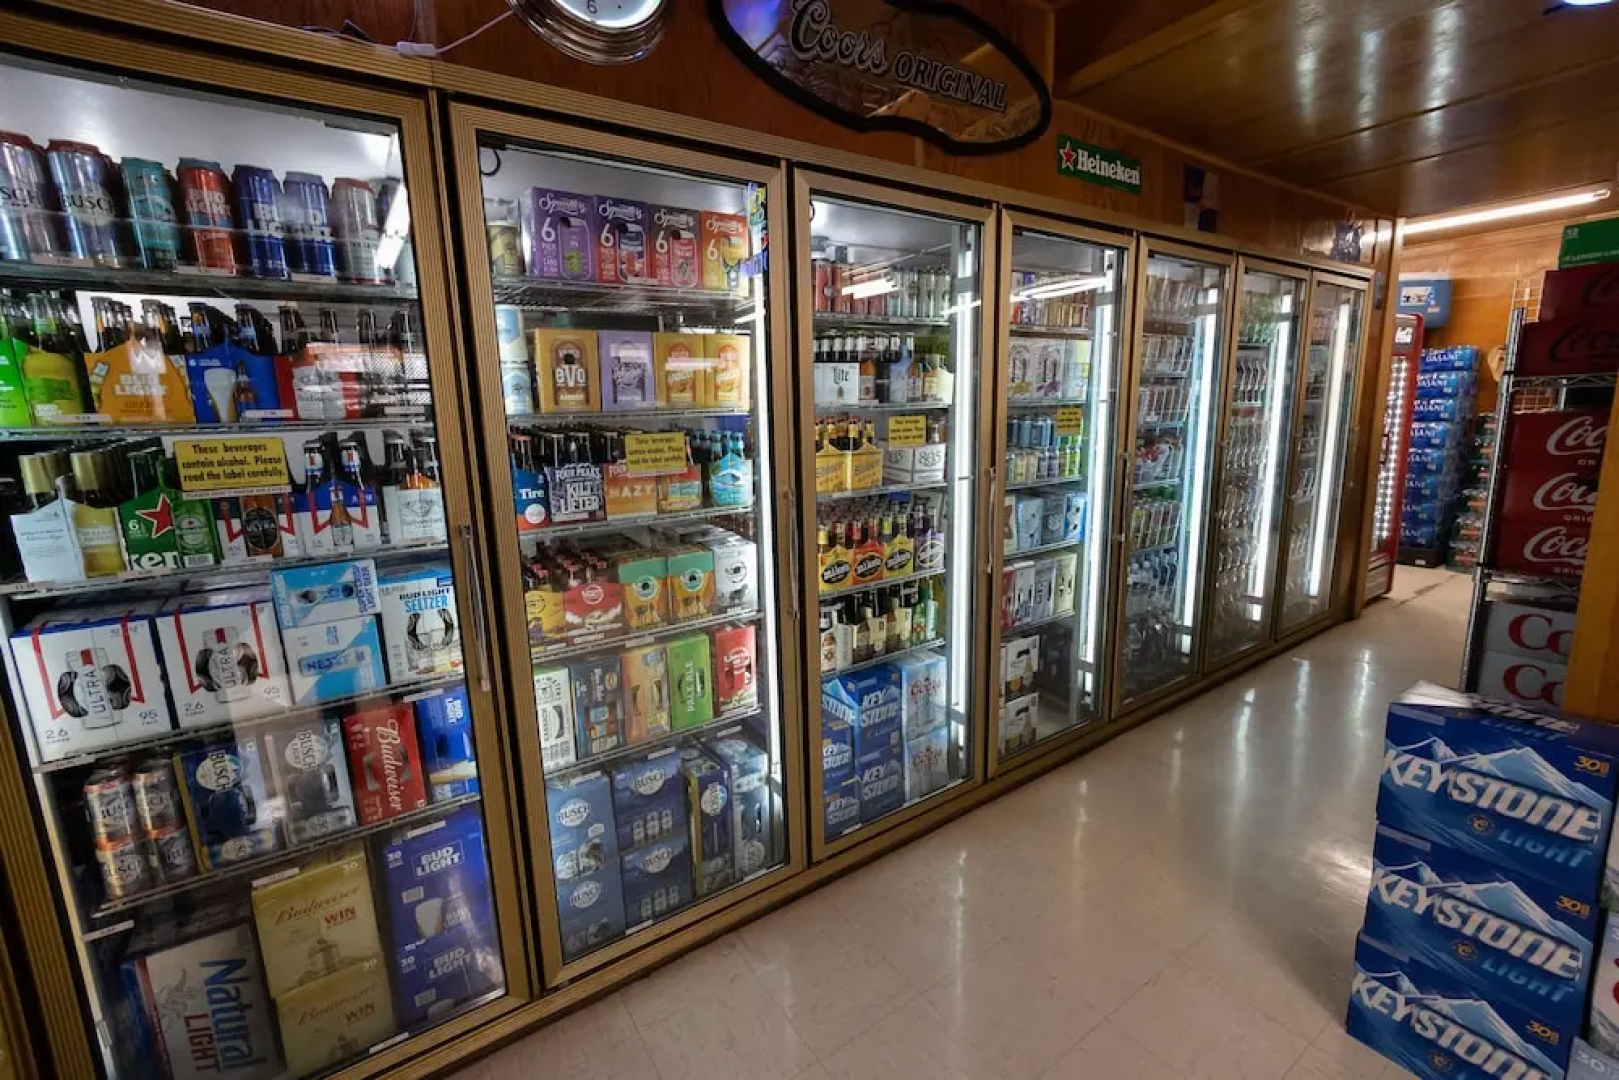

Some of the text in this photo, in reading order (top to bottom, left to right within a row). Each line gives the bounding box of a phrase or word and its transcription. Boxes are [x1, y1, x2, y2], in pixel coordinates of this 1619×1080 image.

[789, 0, 1008, 112] Coors ORIGINAL
[1076, 149, 1141, 186] Heineken
[542, 217, 556, 241] 6
[601, 223, 614, 247] 6
[656, 230, 668, 254] 6
[707, 239, 718, 260] 6
[182, 458, 214, 469] contain
[254, 454, 282, 464] Please
[191, 442, 267, 454] These beverages
[184, 471, 204, 482] read
[206, 470, 220, 480] the
[223, 468, 245, 479] label
[518, 488, 545, 499] Tire
[404, 595, 448, 613] SELTZER
[217, 643, 237, 687] ULTRA
[84, 670, 107, 713] ULTRA
[295, 729, 318, 770] BUSCH
[375, 718, 404, 811] Budweiser
[208, 750, 227, 791] BUSCH
[1383, 750, 1602, 844] KEYSTONE
[415, 852, 461, 877] LIGHT
[420, 846, 454, 866] BUD
[1497, 829, 1594, 868] LIGHT
[275, 886, 358, 926] Budweiser
[323, 906, 356, 924] WIN
[1372, 867, 1583, 981] KEYSTONE
[434, 947, 466, 968] BUD
[1481, 958, 1575, 1003] LIGHT
[199, 957, 268, 1070] Natural
[183, 1013, 221, 1074] LIGHT
